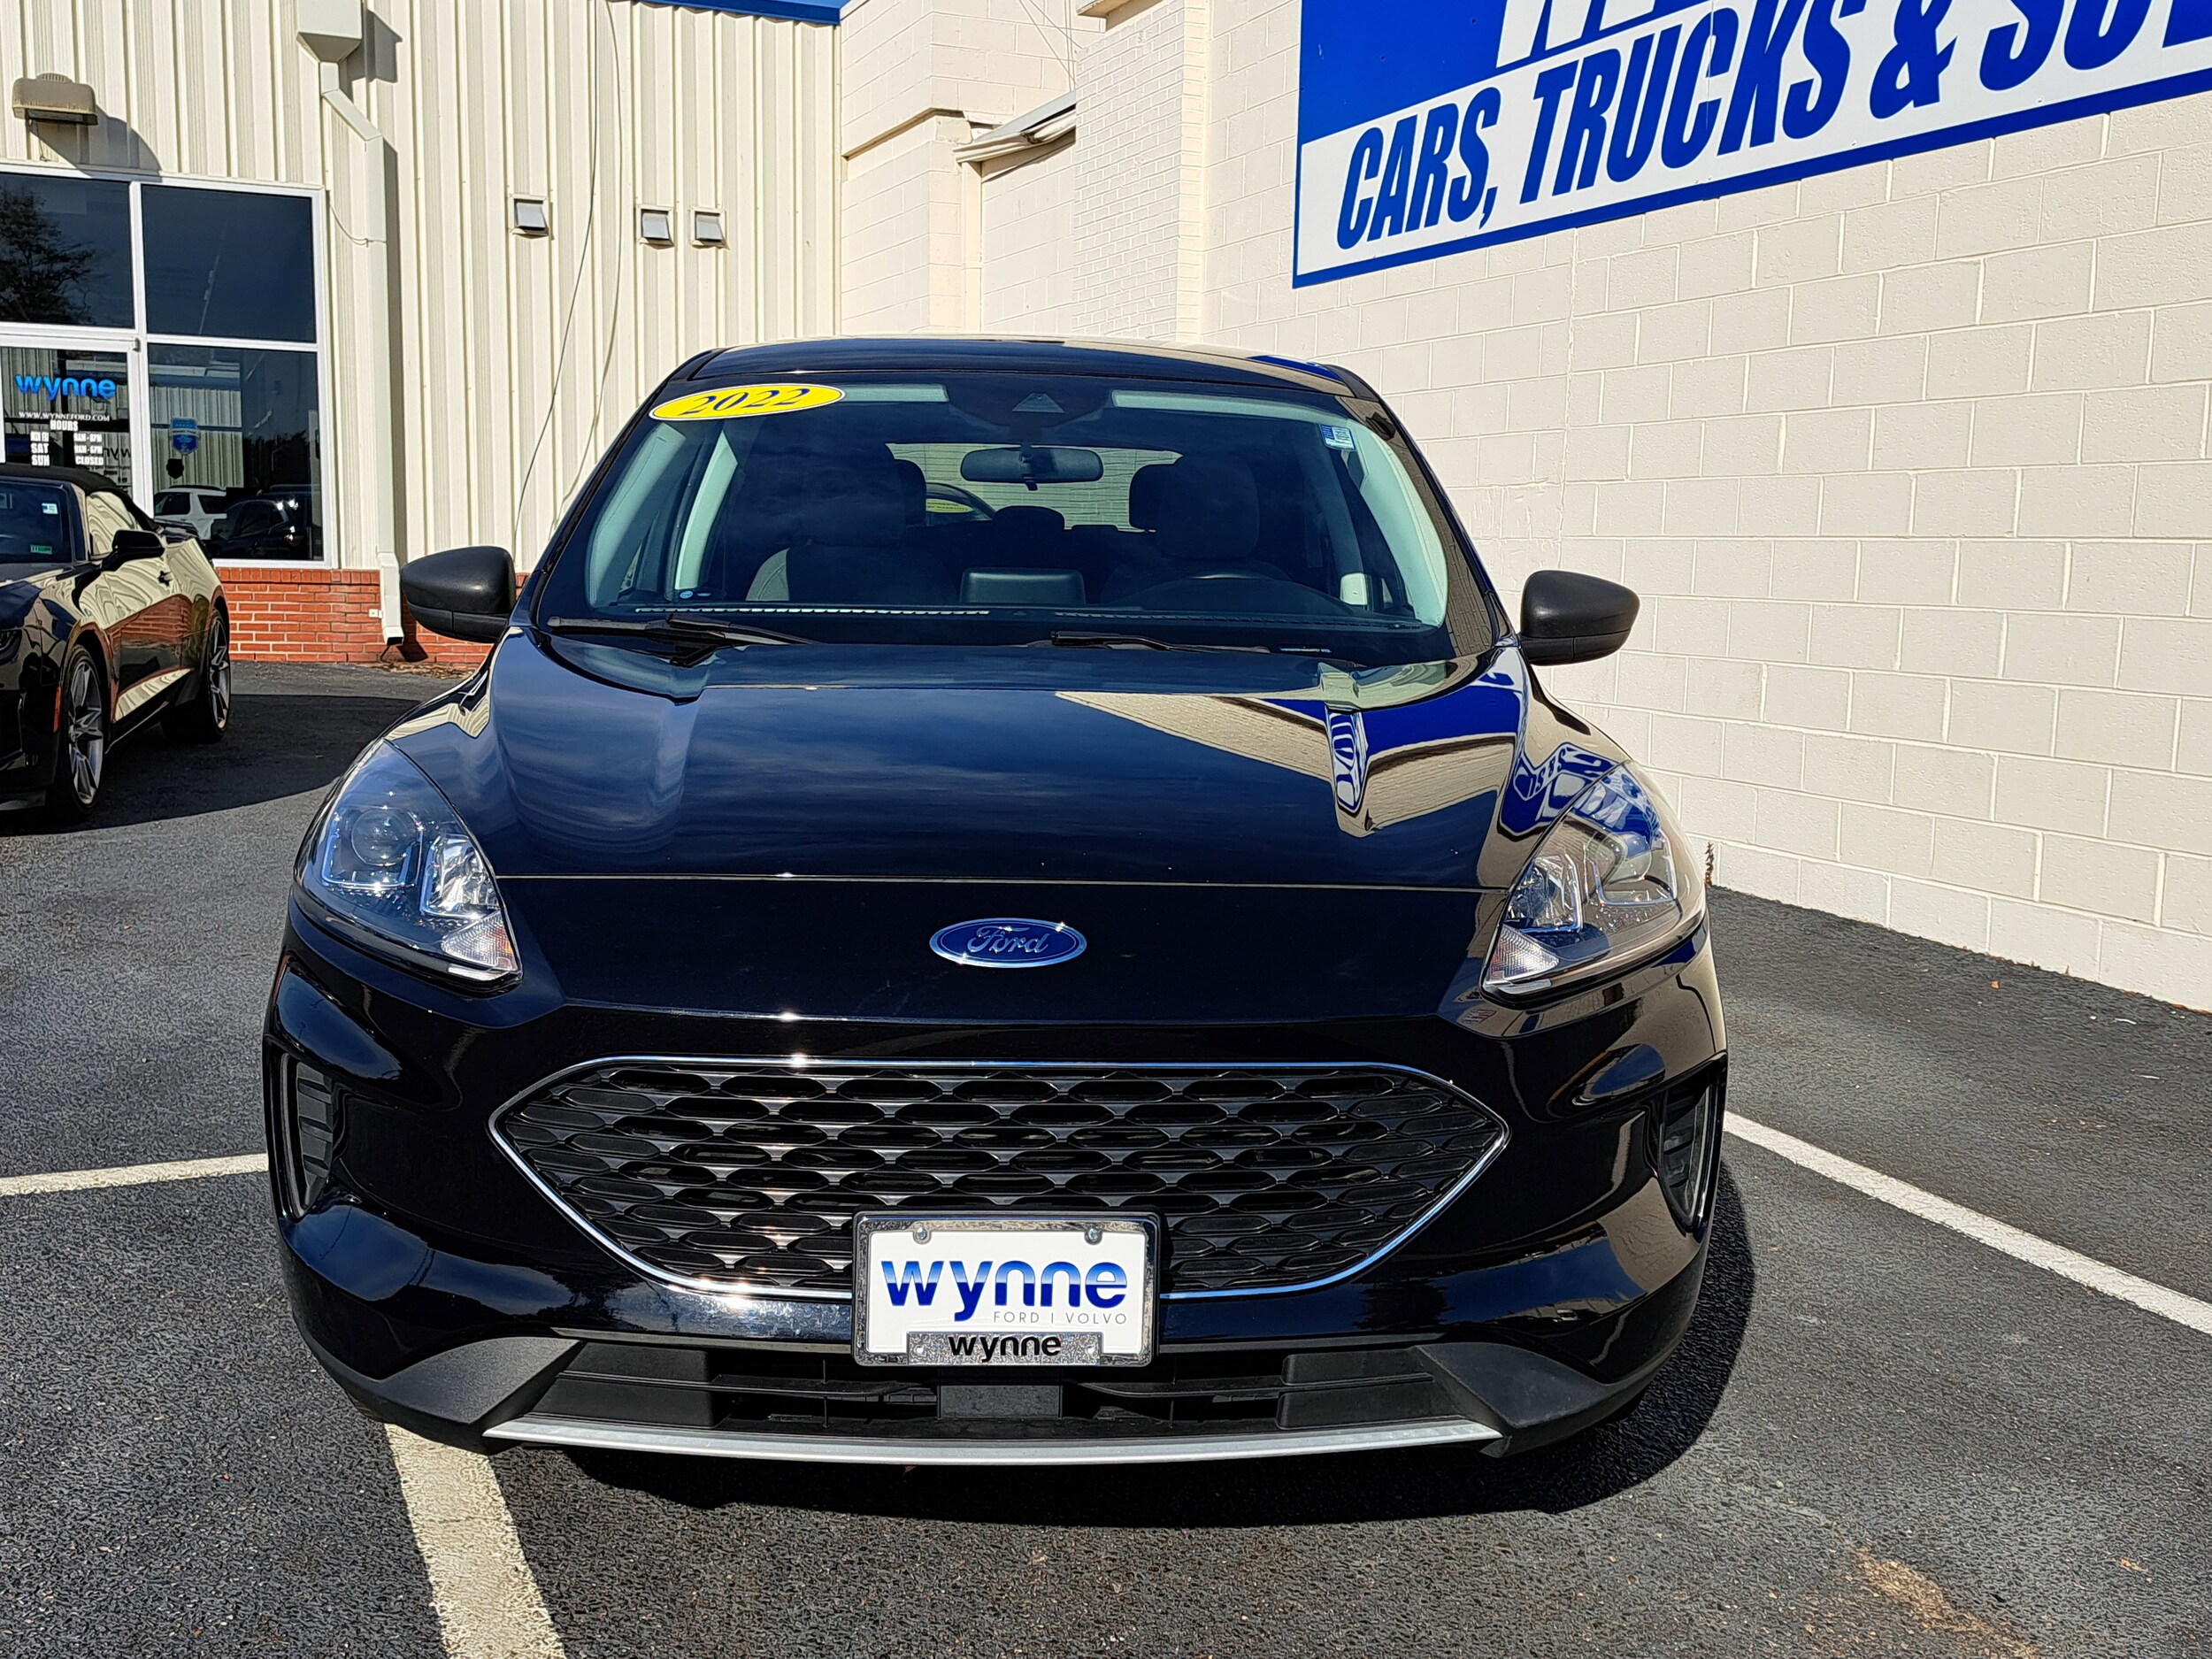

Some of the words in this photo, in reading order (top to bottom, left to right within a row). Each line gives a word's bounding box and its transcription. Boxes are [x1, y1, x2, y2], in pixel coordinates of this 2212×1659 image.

[1337, 87, 1502, 250] CARS,
[1519, 0, 1865, 204] TRUCKS
[1870, 0, 1958, 119] &
[15, 374, 117, 401] wynne
[676, 388, 810, 416] 2022
[50, 419, 79, 431] HOURS
[30, 443, 49, 453] SAT
[31, 455, 50, 466] SUN
[75, 456, 104, 465] CLOSED
[967, 926, 1050, 954] Ford
[880, 1261, 1127, 1322] wynne
[994, 1311, 1040, 1324] FORD
[1065, 1312, 1127, 1325] VOLVO
[949, 1335, 1062, 1363] wynne
